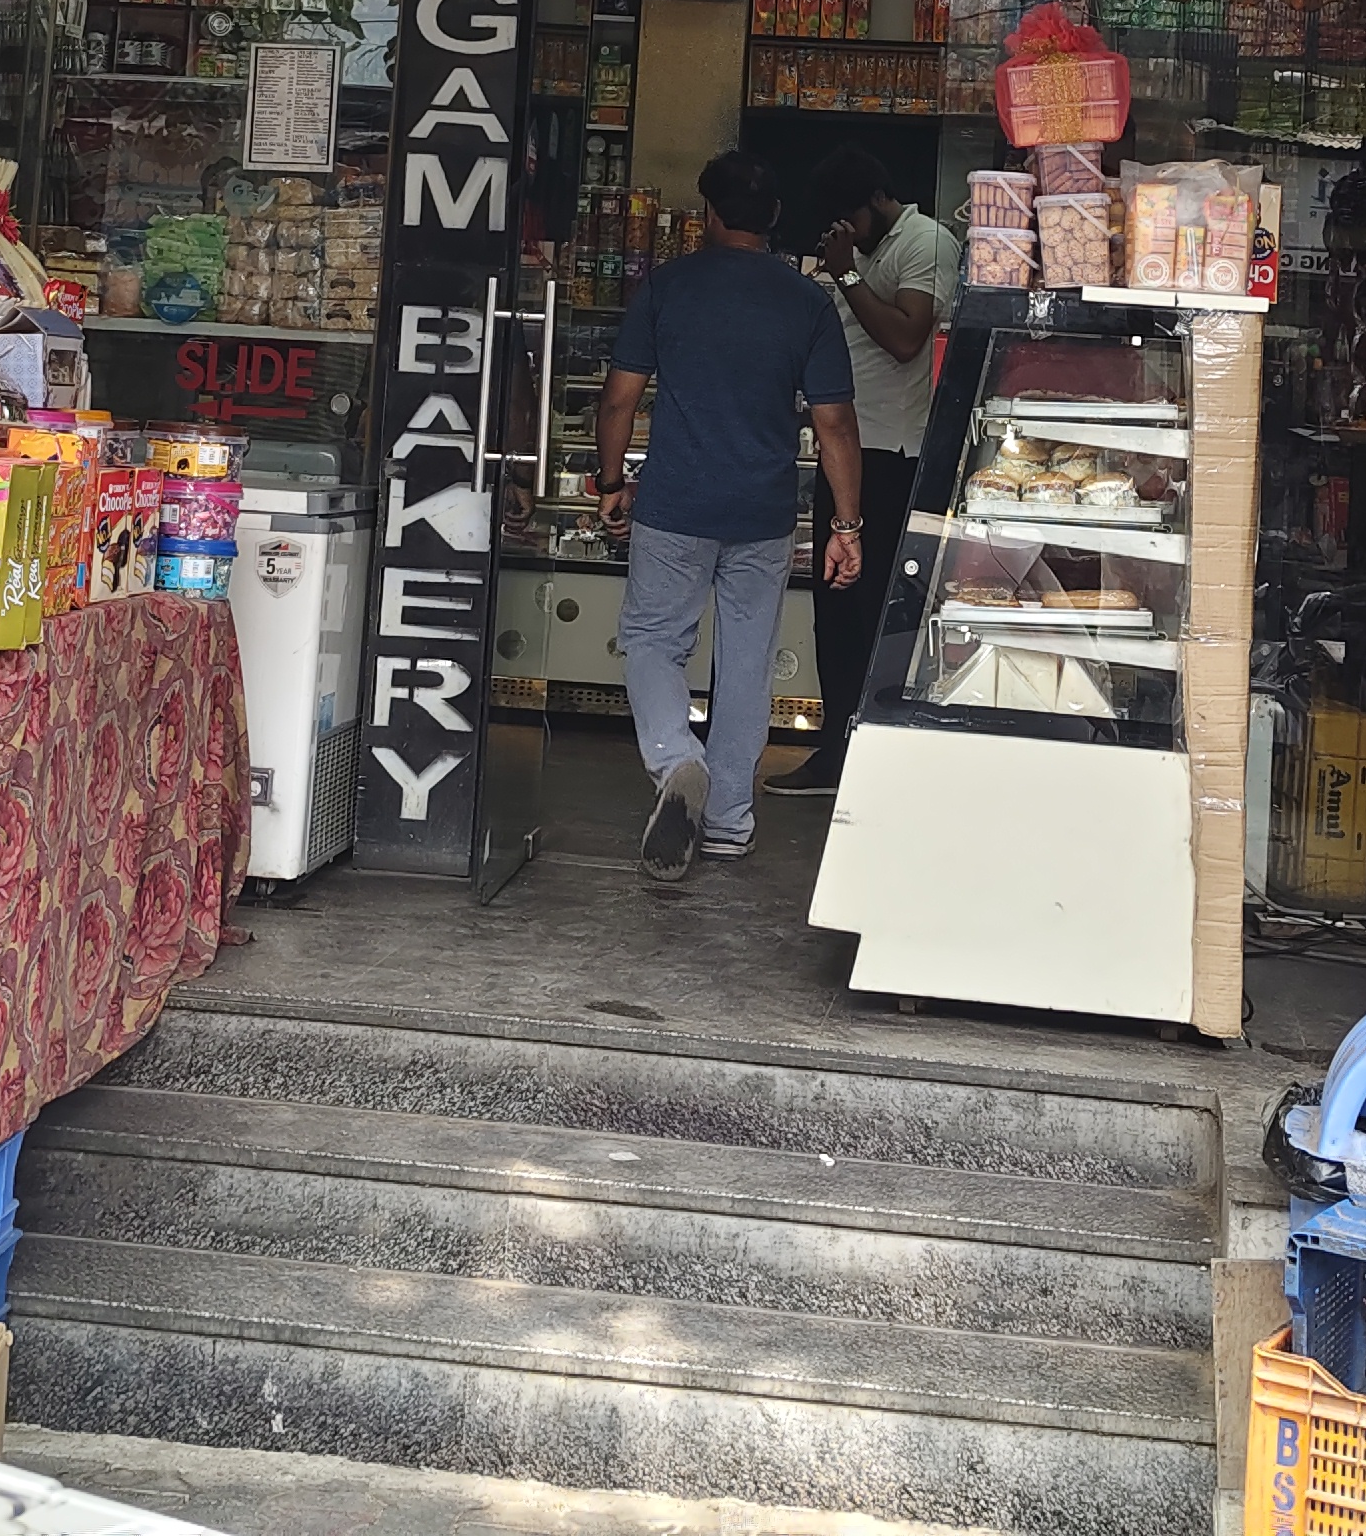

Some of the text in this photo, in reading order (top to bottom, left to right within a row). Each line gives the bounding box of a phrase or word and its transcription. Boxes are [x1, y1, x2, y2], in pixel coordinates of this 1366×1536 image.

[176, 341, 317, 398] SLIDE
[99, 491, 133, 513] ChocoPie
[266, 558, 292, 575] 5 YEAR
[369, 305, 495, 821] BAKERY
[1325, 766, 1352, 839] Amul
